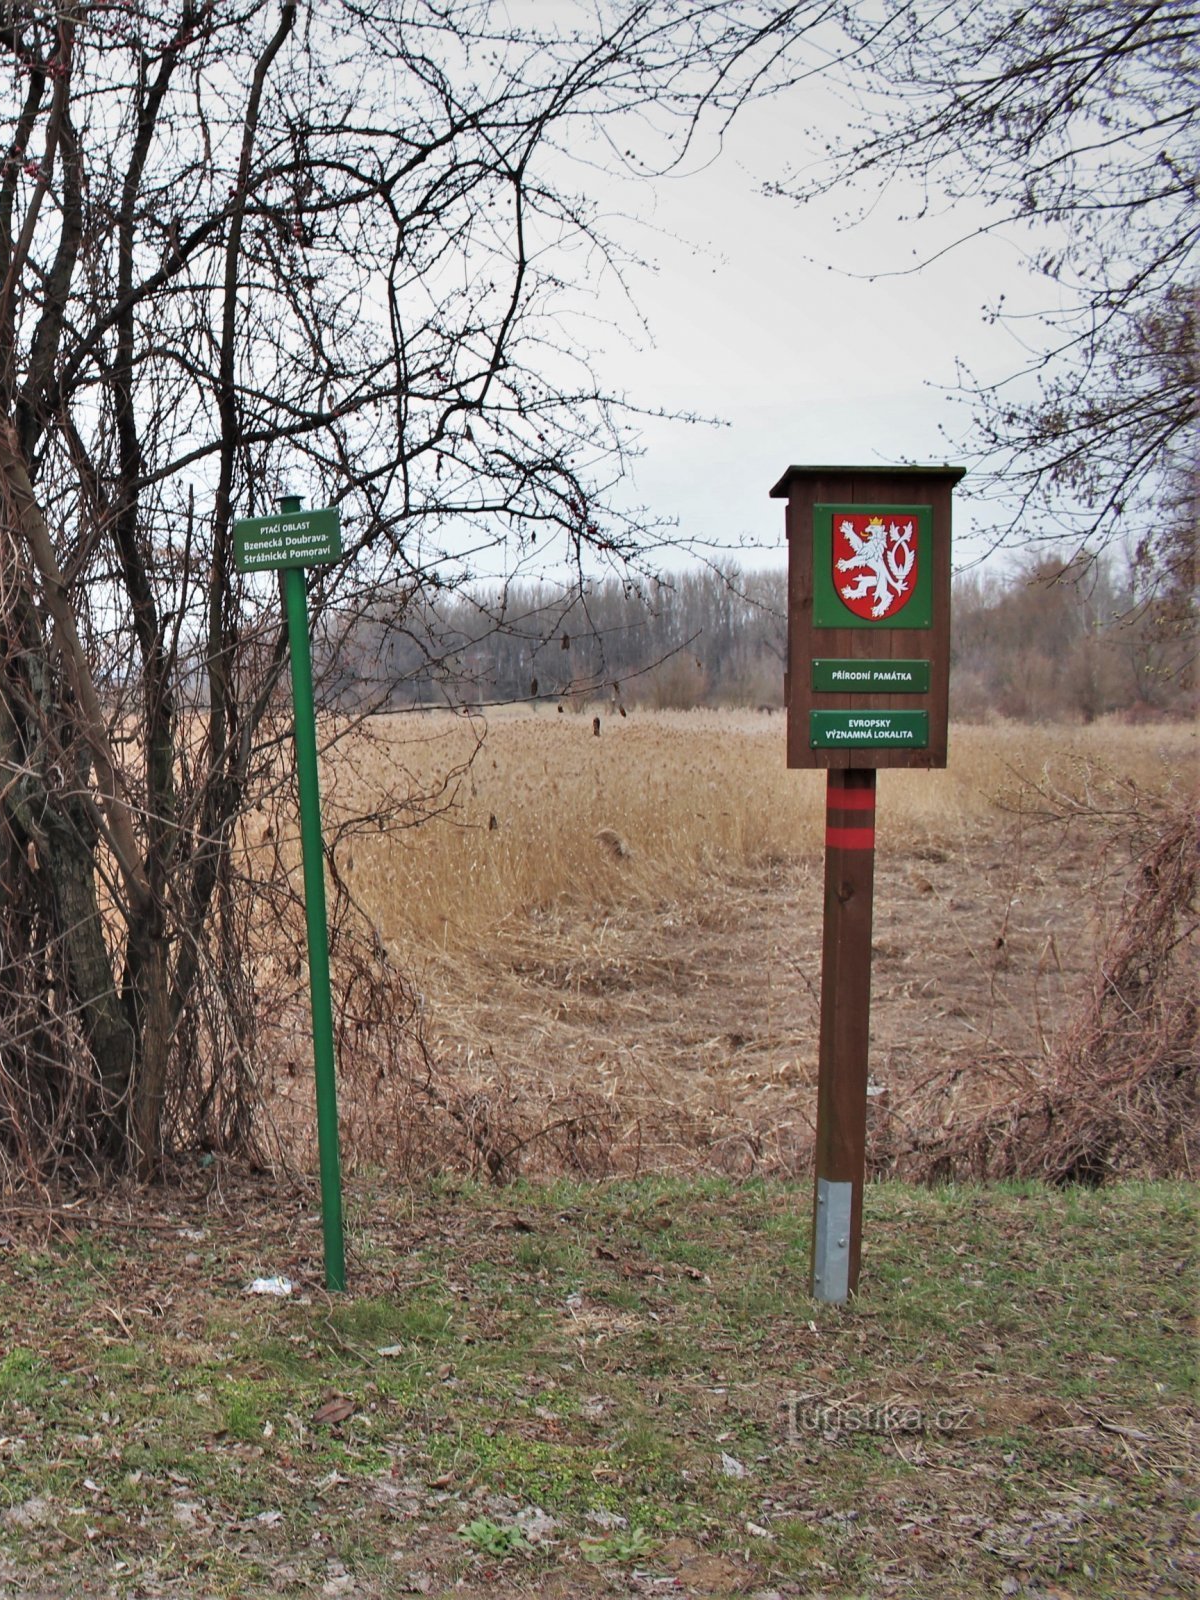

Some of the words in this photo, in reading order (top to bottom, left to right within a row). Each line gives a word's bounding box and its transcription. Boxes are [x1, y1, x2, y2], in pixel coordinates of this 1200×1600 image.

[260, 524, 281, 535] PTAČÍ
[282, 522, 310, 532] OBLAST
[244, 537, 282, 551] Bzenecká
[244, 550, 287, 564] Strážnické
[290, 545, 330, 558] Pomoraví
[832, 670, 870, 680] PŘÍRODNÍ
[874, 671, 912, 680] PAMÁTKA
[826, 729, 872, 738] VÝZNAMNÁ
